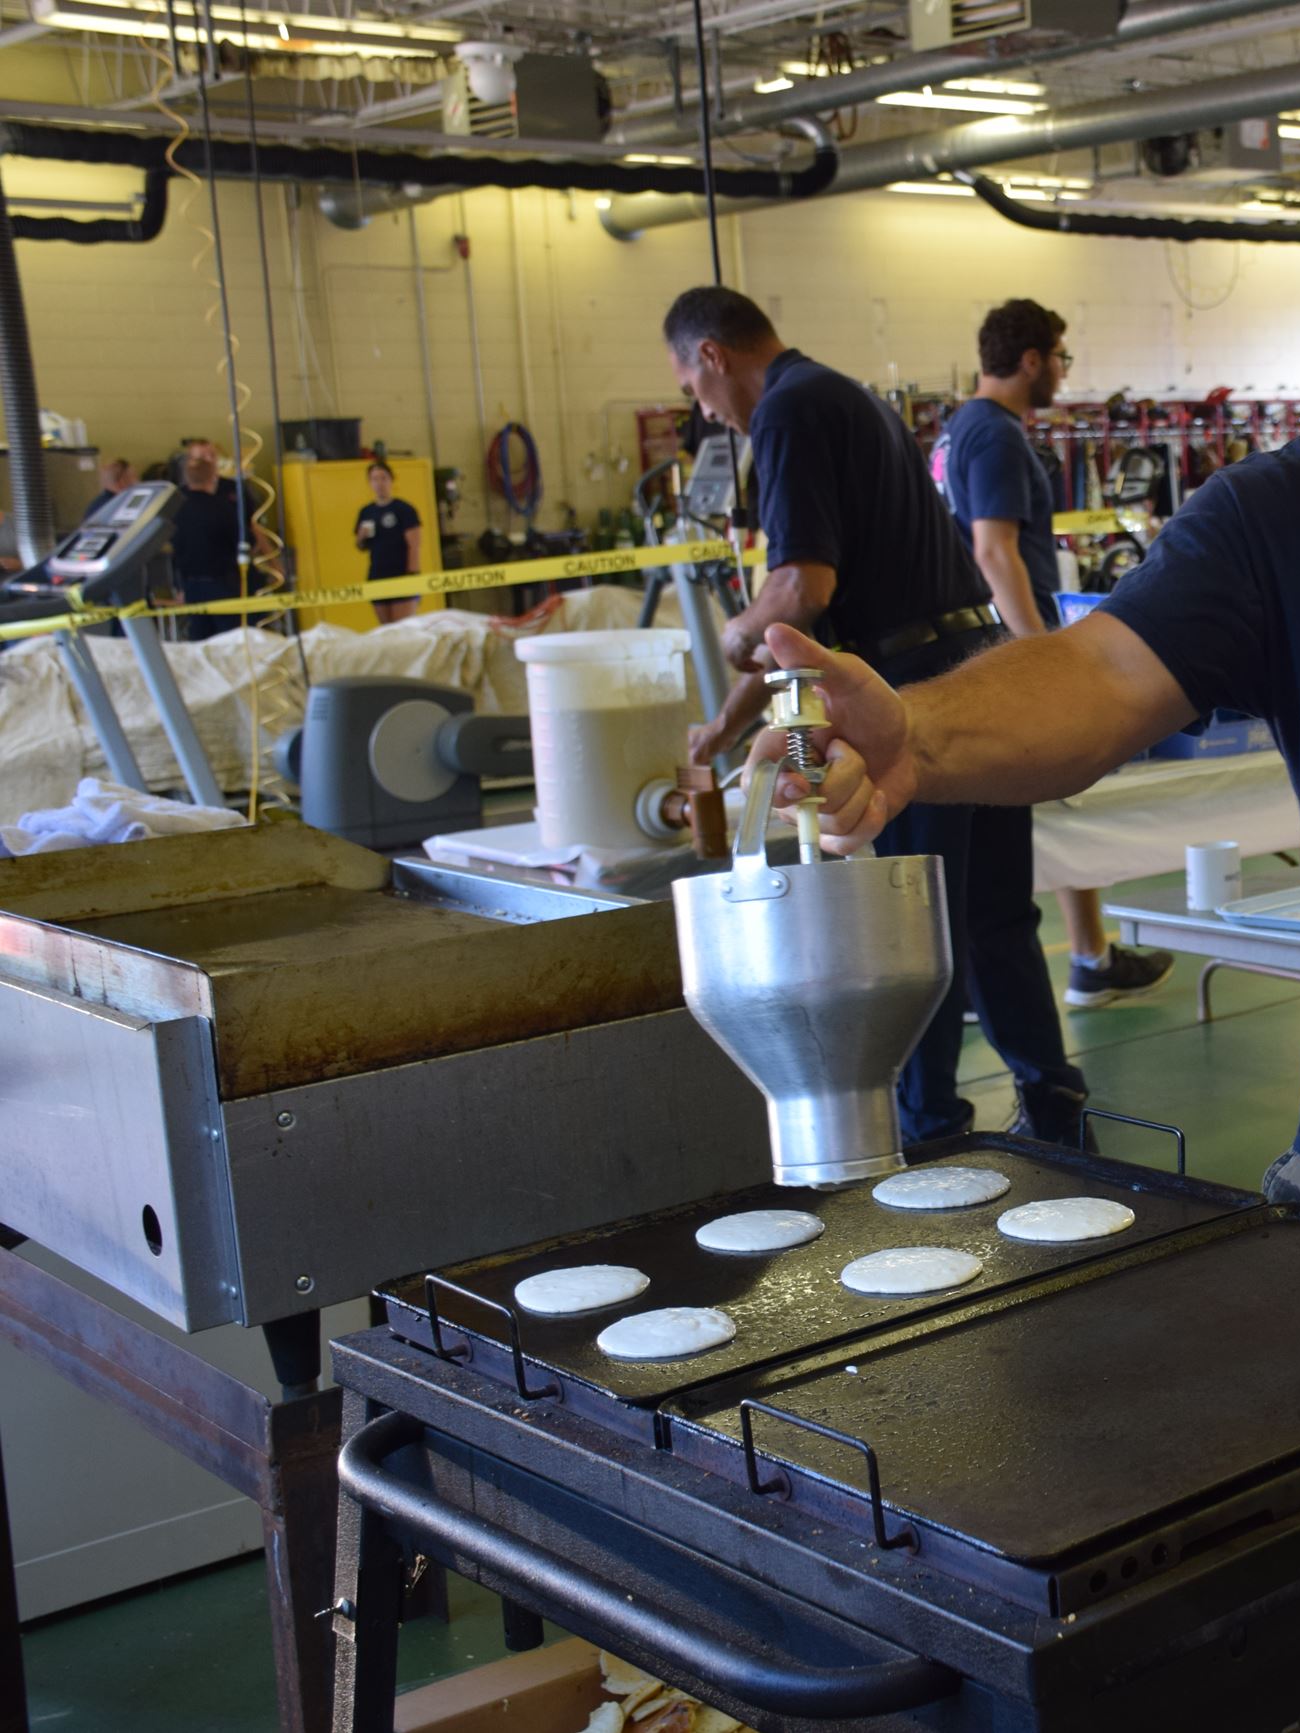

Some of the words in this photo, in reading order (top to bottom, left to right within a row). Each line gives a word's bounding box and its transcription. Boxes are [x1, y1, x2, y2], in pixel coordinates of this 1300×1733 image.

[278, 586, 364, 606] CAUTION
[427, 569, 506, 591] CAUTION
[564, 555, 636, 576] CAUTION
